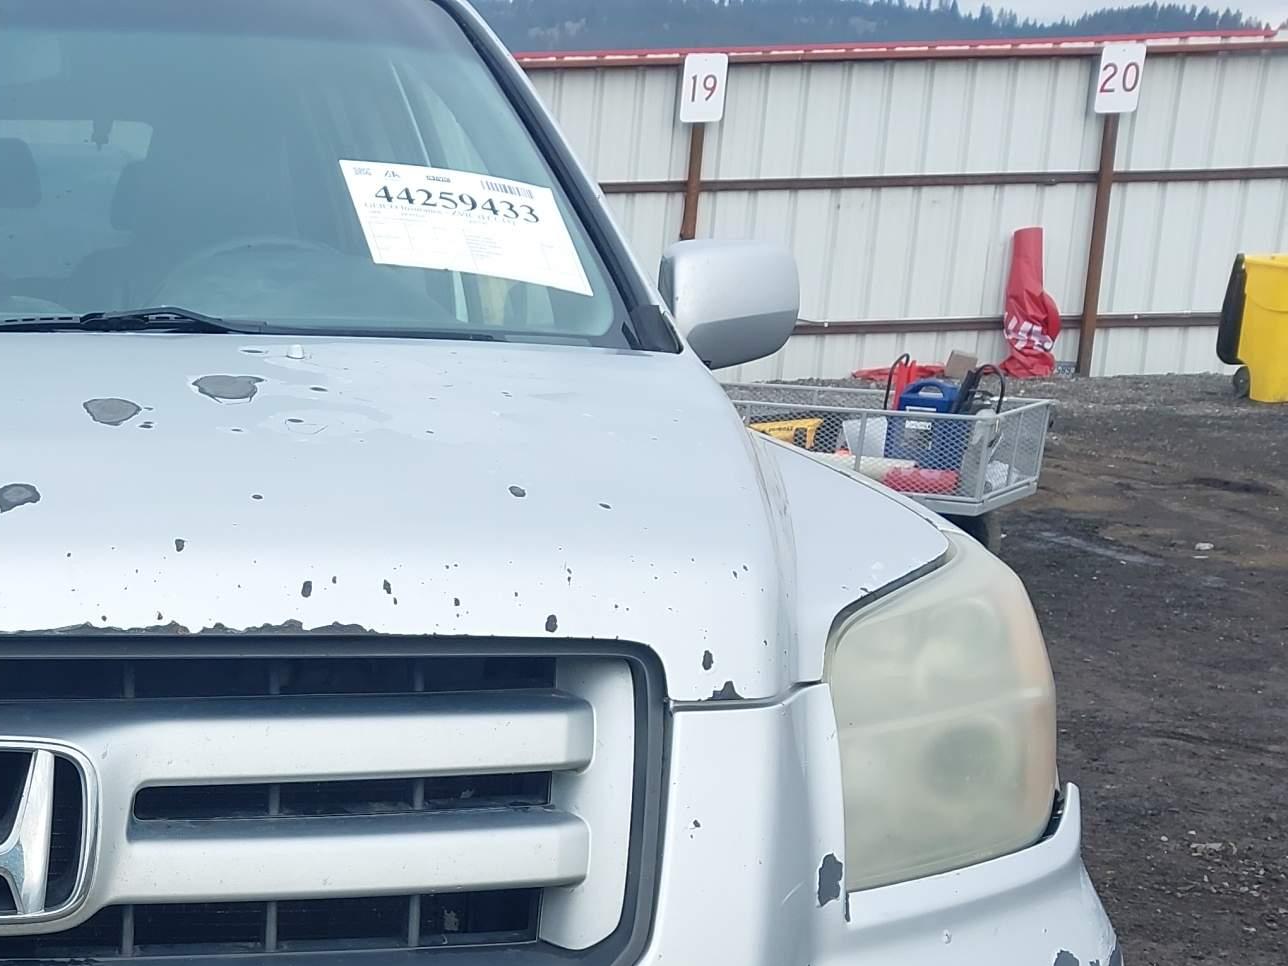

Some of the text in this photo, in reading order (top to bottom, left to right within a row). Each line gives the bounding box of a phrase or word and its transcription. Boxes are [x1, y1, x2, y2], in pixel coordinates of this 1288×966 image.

[691, 74, 718, 103] 19
[1099, 61, 1141, 93] 20
[374, 185, 540, 223] 44259433
